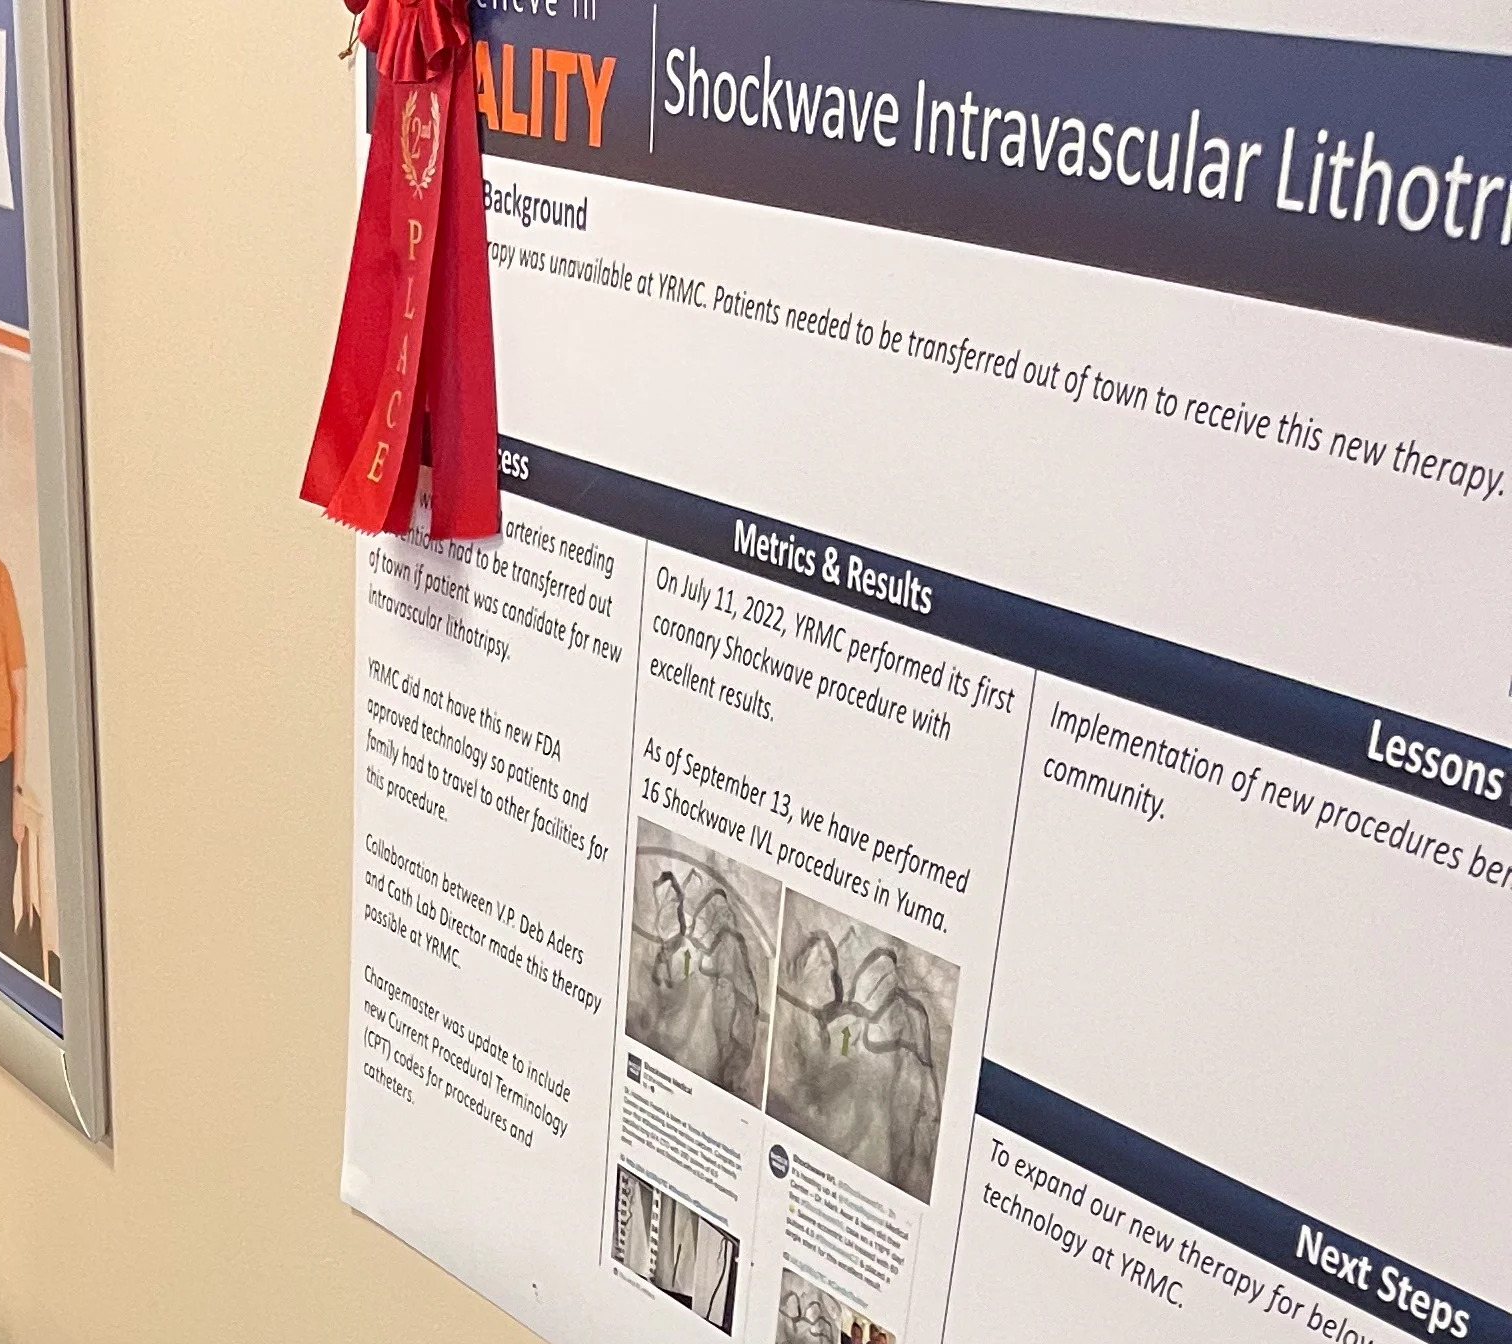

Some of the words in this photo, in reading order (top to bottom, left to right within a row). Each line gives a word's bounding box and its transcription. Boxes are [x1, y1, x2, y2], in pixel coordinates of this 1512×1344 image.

[664, 46, 899, 147] Shockwave
[914, 79, 1262, 203] Intravascular
[483, 180, 587, 231] Background
[519, 248, 545, 272] was
[550, 252, 632, 292] unavailable
[637, 272, 653, 297] at
[659, 273, 707, 308] YRMC.
[713, 285, 781, 326] Patients
[786, 306, 851, 341] needed
[855, 319, 873, 346] to
[879, 321, 902, 353] be
[908, 330, 1021, 374] transferred
[1024, 362, 1060, 389] out
[1065, 365, 1091, 403] of
[1093, 372, 1147, 410] town
[1155, 387, 1177, 417] to
[1184, 398, 1271, 439] receive
[1277, 412, 1323, 450] this
[1329, 432, 1386, 466] new
[1392, 439, 1504, 501] therapy.
[369, 548, 380, 574] of
[382, 555, 410, 582] town
[414, 563, 424, 589] if
[425, 573, 469, 604] patient
[474, 590, 498, 614] was
[502, 601, 566, 641] candidate
[568, 622, 589, 651] for
[592, 637, 622, 663] new
[448, 539, 472, 565] had
[476, 551, 489, 570] to
[492, 551, 508, 578] be
[512, 562, 586, 606] transferred
[589, 592, 612, 617] out
[505, 520, 555, 554] arteries
[559, 538, 615, 579] needing
[734, 519, 816, 577] Metrics
[822, 547, 840, 584] &
[847, 555, 933, 615] Results
[368, 584, 442, 631] intravascular
[445, 614, 511, 663] lithotripsy.
[653, 612, 721, 658] coronary
[723, 635, 814, 690] Shockwave
[817, 671, 908, 724] procedure
[912, 707, 952, 741] with
[657, 566, 677, 594] On
[681, 574, 710, 612] July
[714, 586, 736, 621] 11,
[743, 595, 787, 638] 2022,
[795, 612, 846, 653] YRMC
[847, 636, 945, 686] performed
[948, 666, 970, 698] its
[971, 674, 1016, 714] first
[368, 656, 400, 690] YRMC
[402, 674, 420, 699] did
[423, 685, 443, 709] not
[447, 692, 476, 724] have
[480, 707, 501, 734] this
[504, 722, 533, 747] new
[535, 731, 561, 762] FDA
[650, 656, 715, 701] excellent
[719, 682, 774, 722] results.
[366, 728, 399, 765] family
[402, 745, 423, 773] had
[428, 760, 439, 781] to
[442, 768, 477, 797] travel
[480, 784, 492, 806] to
[495, 796, 530, 824] other
[531, 808, 585, 851] facilities
[587, 835, 609, 862] for
[367, 698, 419, 735] approved
[421, 720, 488, 770] technology
[490, 754, 504, 773] so
[507, 763, 558, 799] patients
[562, 791, 589, 813] and
[643, 736, 661, 762] As
[665, 748, 683, 775] of
[683, 753, 767, 807] September
[770, 790, 794, 824] 13,
[800, 806, 824, 832] we
[828, 812, 870, 851] have
[872, 838, 971, 894] performed
[1043, 755, 1165, 822] community.
[1050, 702, 1224, 785] Implementation
[1231, 767, 1260, 802] of
[1261, 779, 1315, 816] new
[1315, 800, 1465, 871] procedures
[1367, 719, 1504, 800] Lessons
[366, 833, 438, 887] Collaboration
[442, 872, 492, 916] between
[520, 914, 544, 944] Deb
[547, 930, 584, 965] Aders
[642, 778, 659, 803] 16
[663, 787, 746, 842] Shockwave
[750, 824, 774, 856] IVL
[777, 843, 870, 898] procedures
[874, 878, 890, 907] in
[896, 886, 948, 934] Yuma.
[365, 869, 384, 892] and
[387, 880, 413, 908] Cath
[416, 894, 436, 920] Lab
[440, 907, 487, 947] Director
[489, 937, 522, 968] made
[526, 955, 548, 983] this
[552, 969, 602, 1015] therapy
[363, 1026, 391, 1061] (CPT)
[394, 1049, 424, 1079] codes
[426, 1065, 443, 1090] for
[445, 1080, 507, 1132] procedures
[510, 1122, 533, 1148] and
[364, 965, 440, 1022] Chargemaster
[443, 1014, 465, 1038] was
[468, 1029, 509, 1065] update
[512, 1053, 524, 1074] to
[527, 1061, 571, 1102] include
[364, 999, 386, 1022] new
[389, 1011, 429, 1050] Current
[432, 1037, 493, 1089] Procedural
[496, 1074, 568, 1139] Terminology
[983, 1183, 1087, 1258] technology
[1092, 1246, 1114, 1270] at
[1119, 1252, 1184, 1309] YRMC.
[991, 1139, 1010, 1167] To
[1014, 1149, 1087, 1207] expand
[1090, 1195, 1126, 1227] our
[1129, 1216, 1175, 1253] new
[1179, 1238, 1265, 1301] therapy
[1265, 1284, 1304, 1320] for
[1295, 1224, 1372, 1292] Next
[1377, 1266, 1471, 1338] Steps
